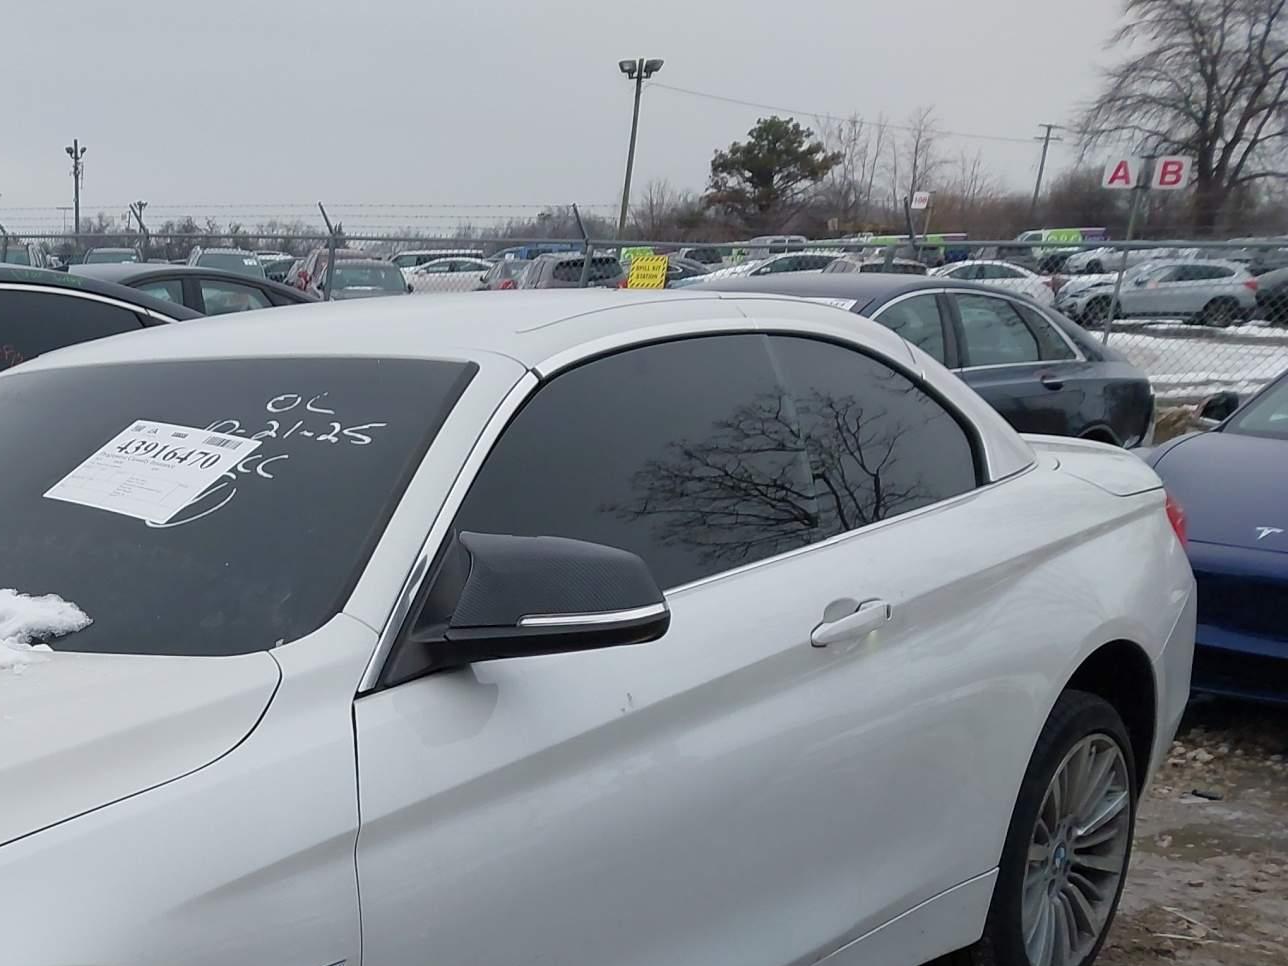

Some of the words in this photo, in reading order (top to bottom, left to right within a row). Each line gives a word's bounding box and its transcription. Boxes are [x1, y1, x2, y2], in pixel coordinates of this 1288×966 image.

[1108, 159, 1130, 185] A
[1159, 159, 1184, 186] B
[116, 438, 221, 470] 43916470
